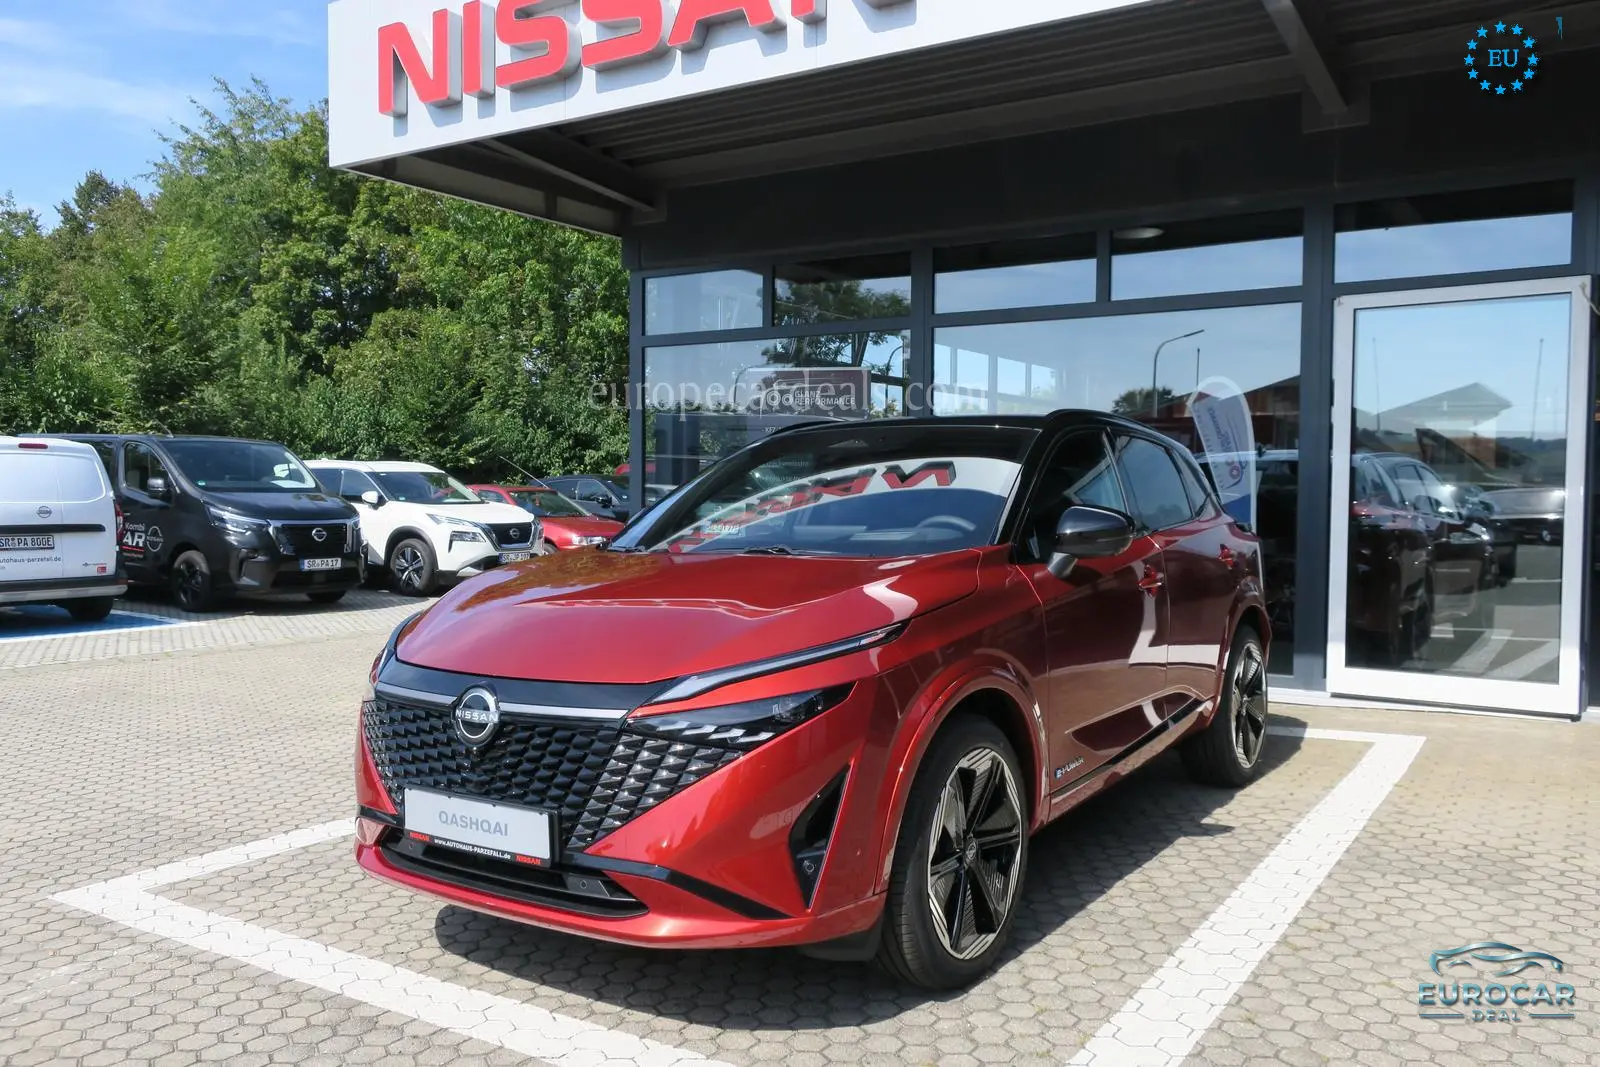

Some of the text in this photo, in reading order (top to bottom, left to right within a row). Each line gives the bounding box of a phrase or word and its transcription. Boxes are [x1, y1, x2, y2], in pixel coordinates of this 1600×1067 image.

[378, 0, 908, 115] NISS
[795, 397, 856, 406] PERFORMANCE
[17, 537, 28, 546] PA
[123, 531, 146, 547] AR
[307, 560, 316, 568] SR
[456, 709, 499, 723] NISSAN
[438, 810, 509, 836] QASHQAI
[409, 832, 430, 842] NISSAN
[516, 853, 542, 865] NISSAN
